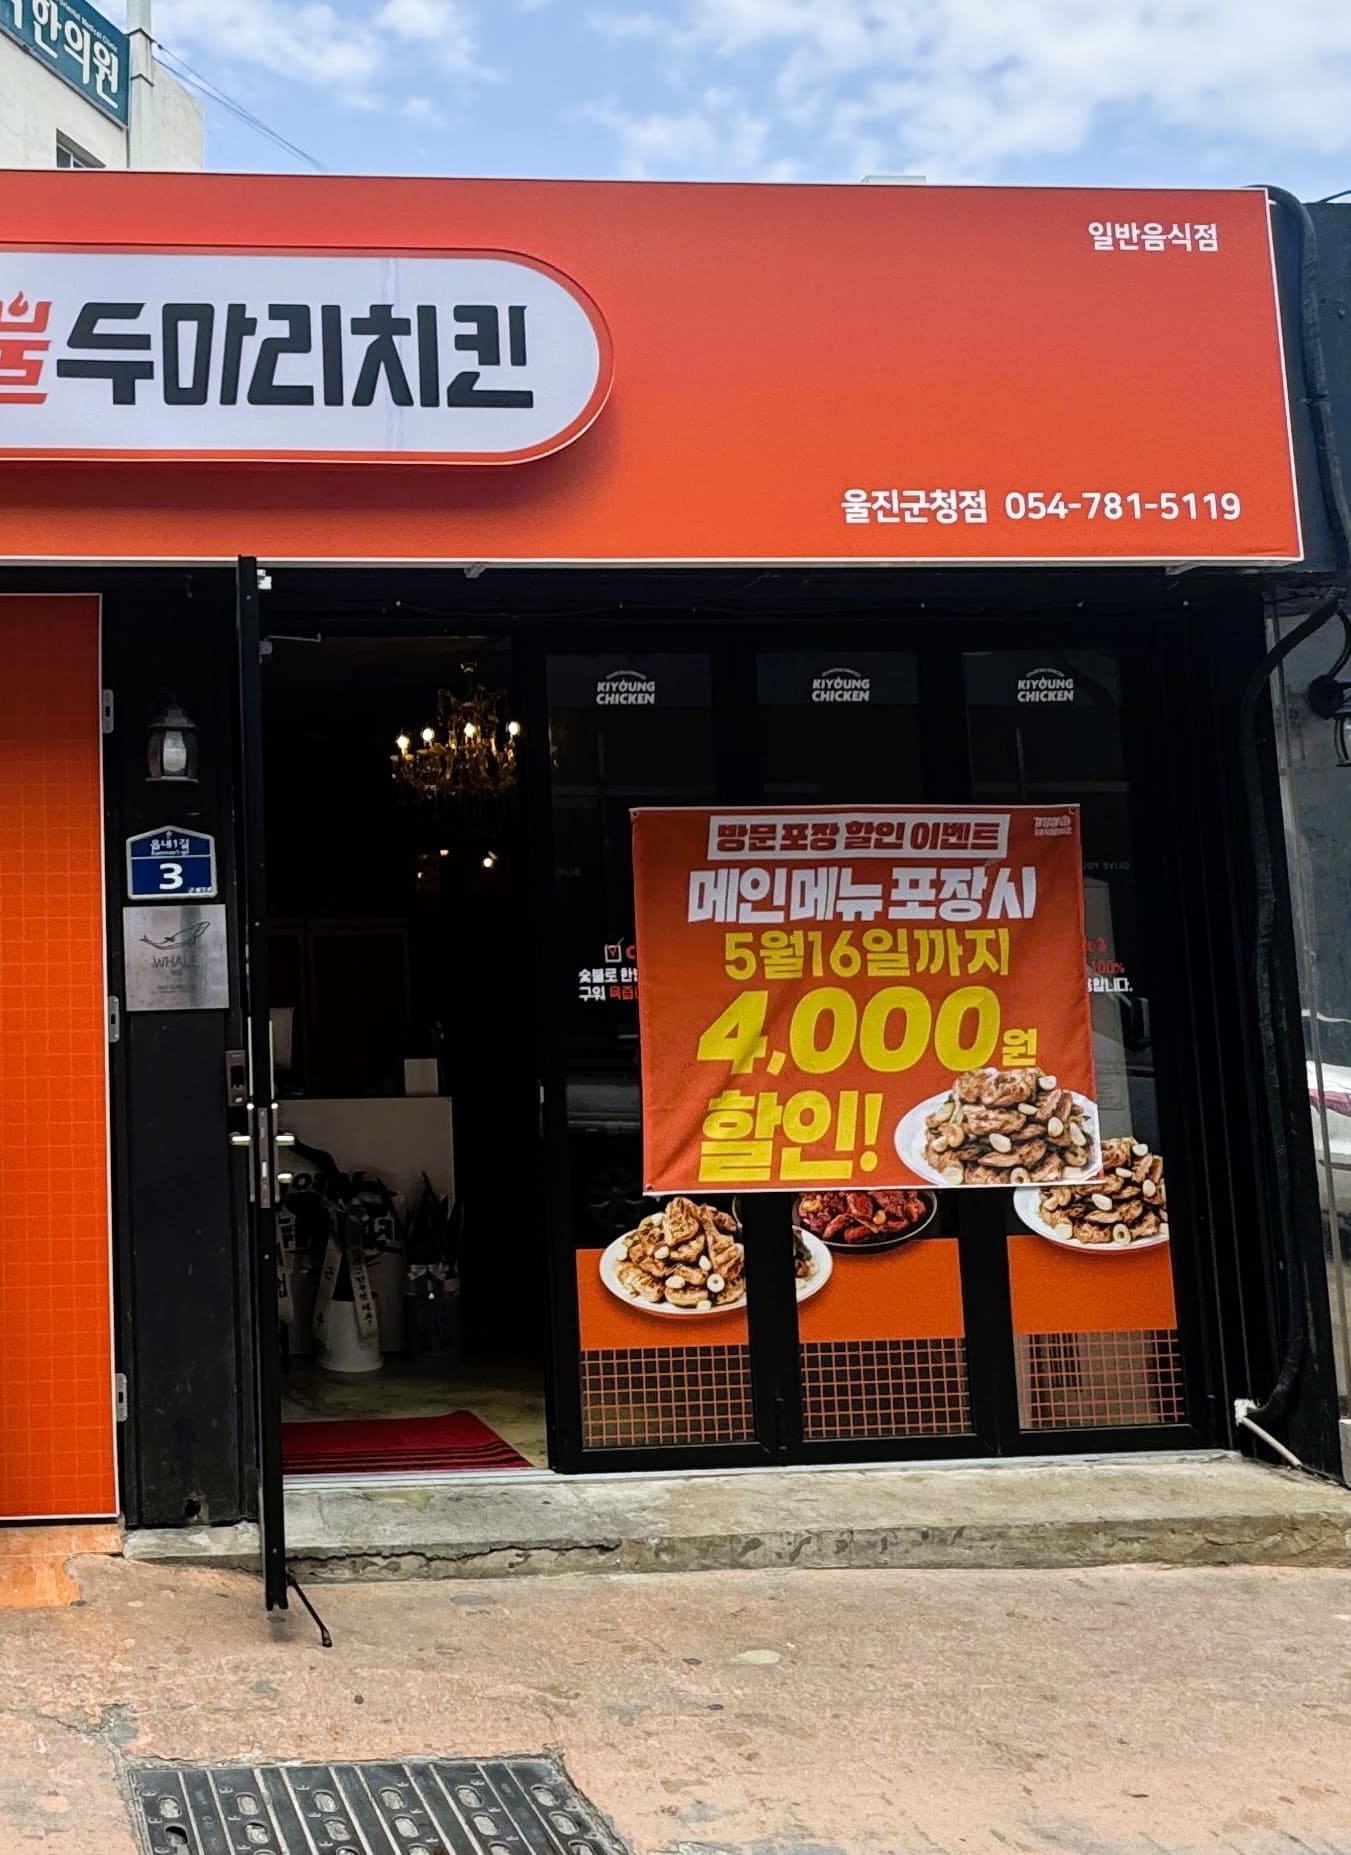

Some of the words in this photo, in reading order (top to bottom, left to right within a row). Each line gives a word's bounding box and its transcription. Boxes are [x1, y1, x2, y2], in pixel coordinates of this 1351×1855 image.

[12, 0, 118, 109] 한의원
[1088, 222, 1219, 252] 일반음식점
[841, 488, 988, 523] 울진군청점
[1005, 492, 1241, 519] 054-781-5119
[597, 678, 656, 692] KIYOUNG
[812, 677, 870, 690] KIYOUNG
[1017, 677, 1074, 690] KIYOUNG
[596, 692, 655, 705] CHICKEN
[811, 690, 869, 702] CHICKEN
[1016, 690, 1074, 702] CHICKEN
[717, 823, 776, 851] 방문
[780, 823, 840, 851] 포장
[844, 821, 906, 850] 할인
[910, 822, 1000, 850] 이벤트
[150, 839, 189, 850] 읍내1길
[159, 862, 184, 890] 3
[578, 984, 606, 1003] 구워
[698, 1090, 884, 1183] 할인!
